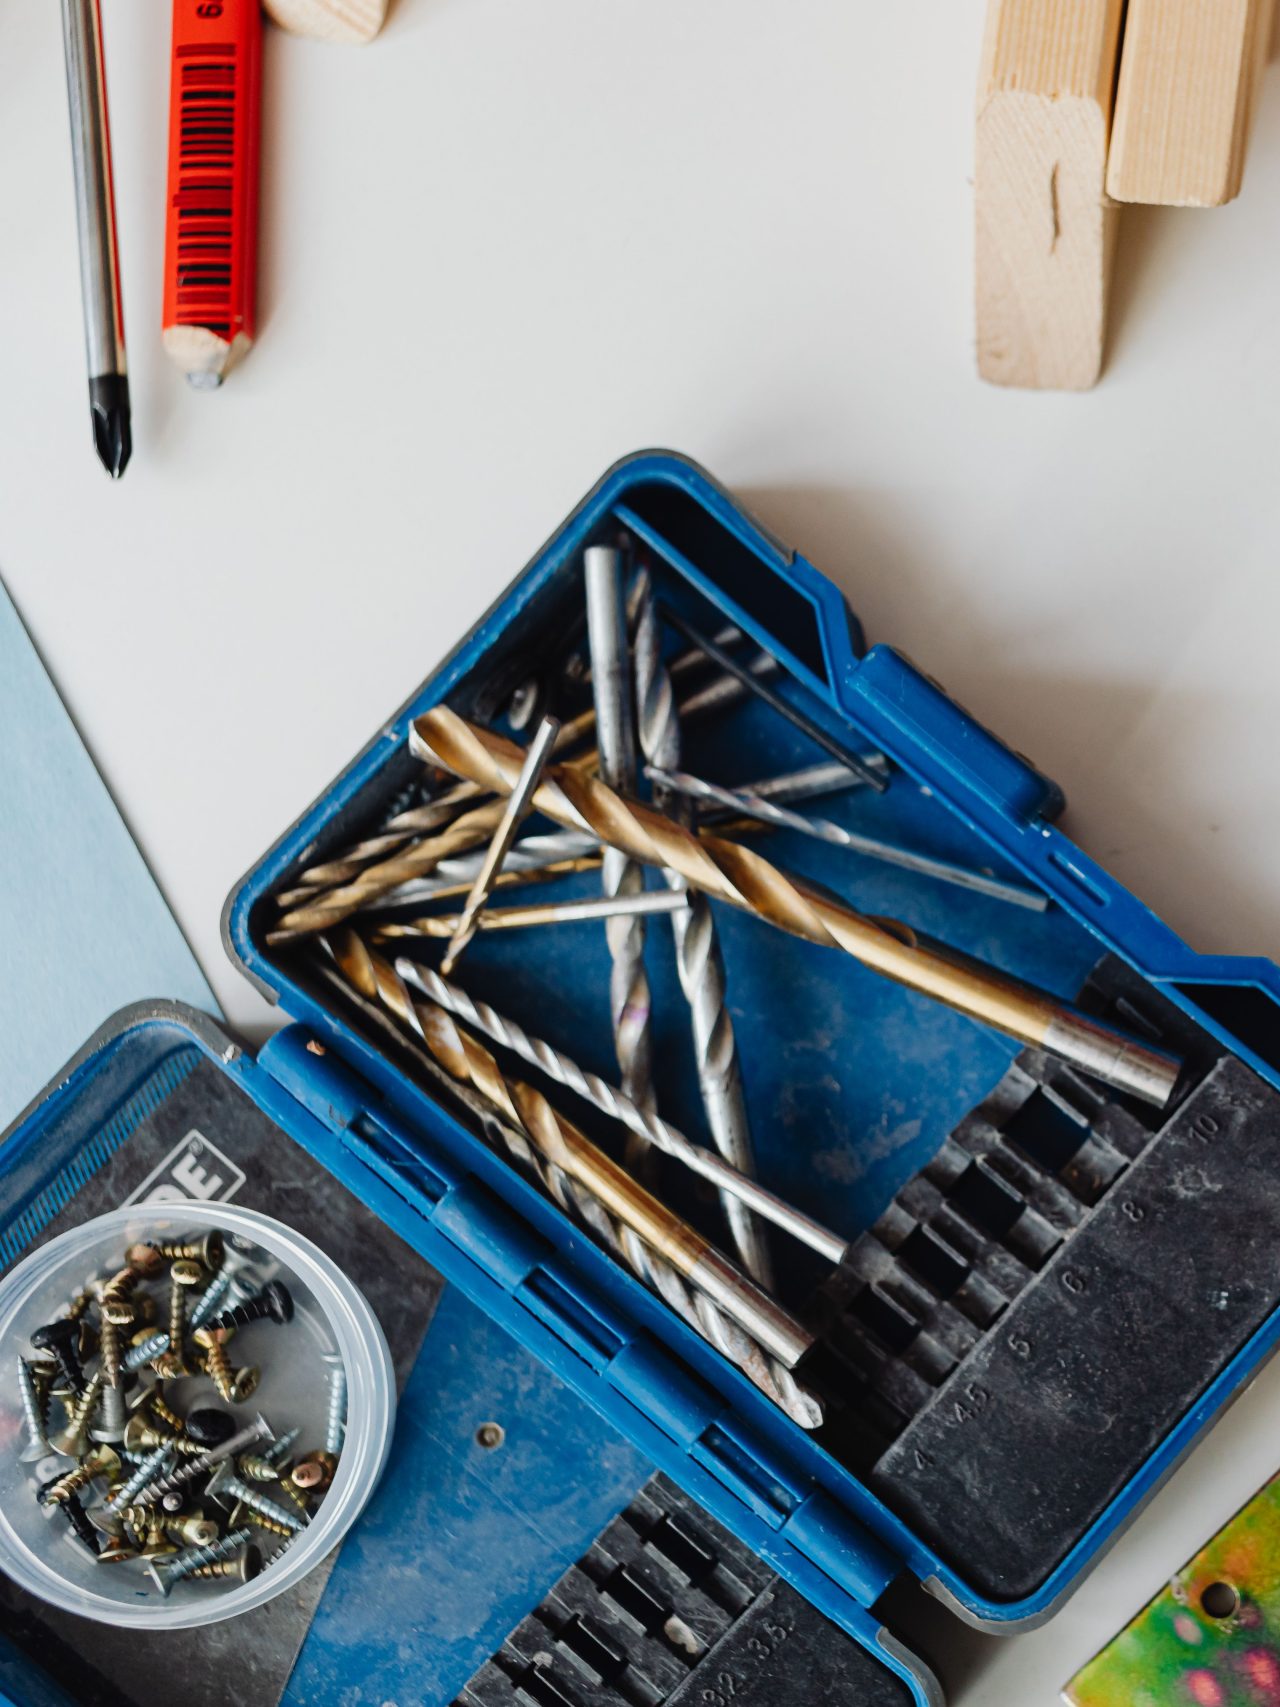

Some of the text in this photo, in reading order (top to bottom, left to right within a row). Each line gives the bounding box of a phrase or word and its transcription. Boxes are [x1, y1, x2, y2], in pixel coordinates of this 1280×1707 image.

[913, 1448, 934, 1471] 4
[1008, 1333, 1033, 1358] 5
[1062, 1270, 1087, 1294] 6
[1122, 1201, 1145, 1222] 8
[1188, 1114, 1219, 1145] 10
